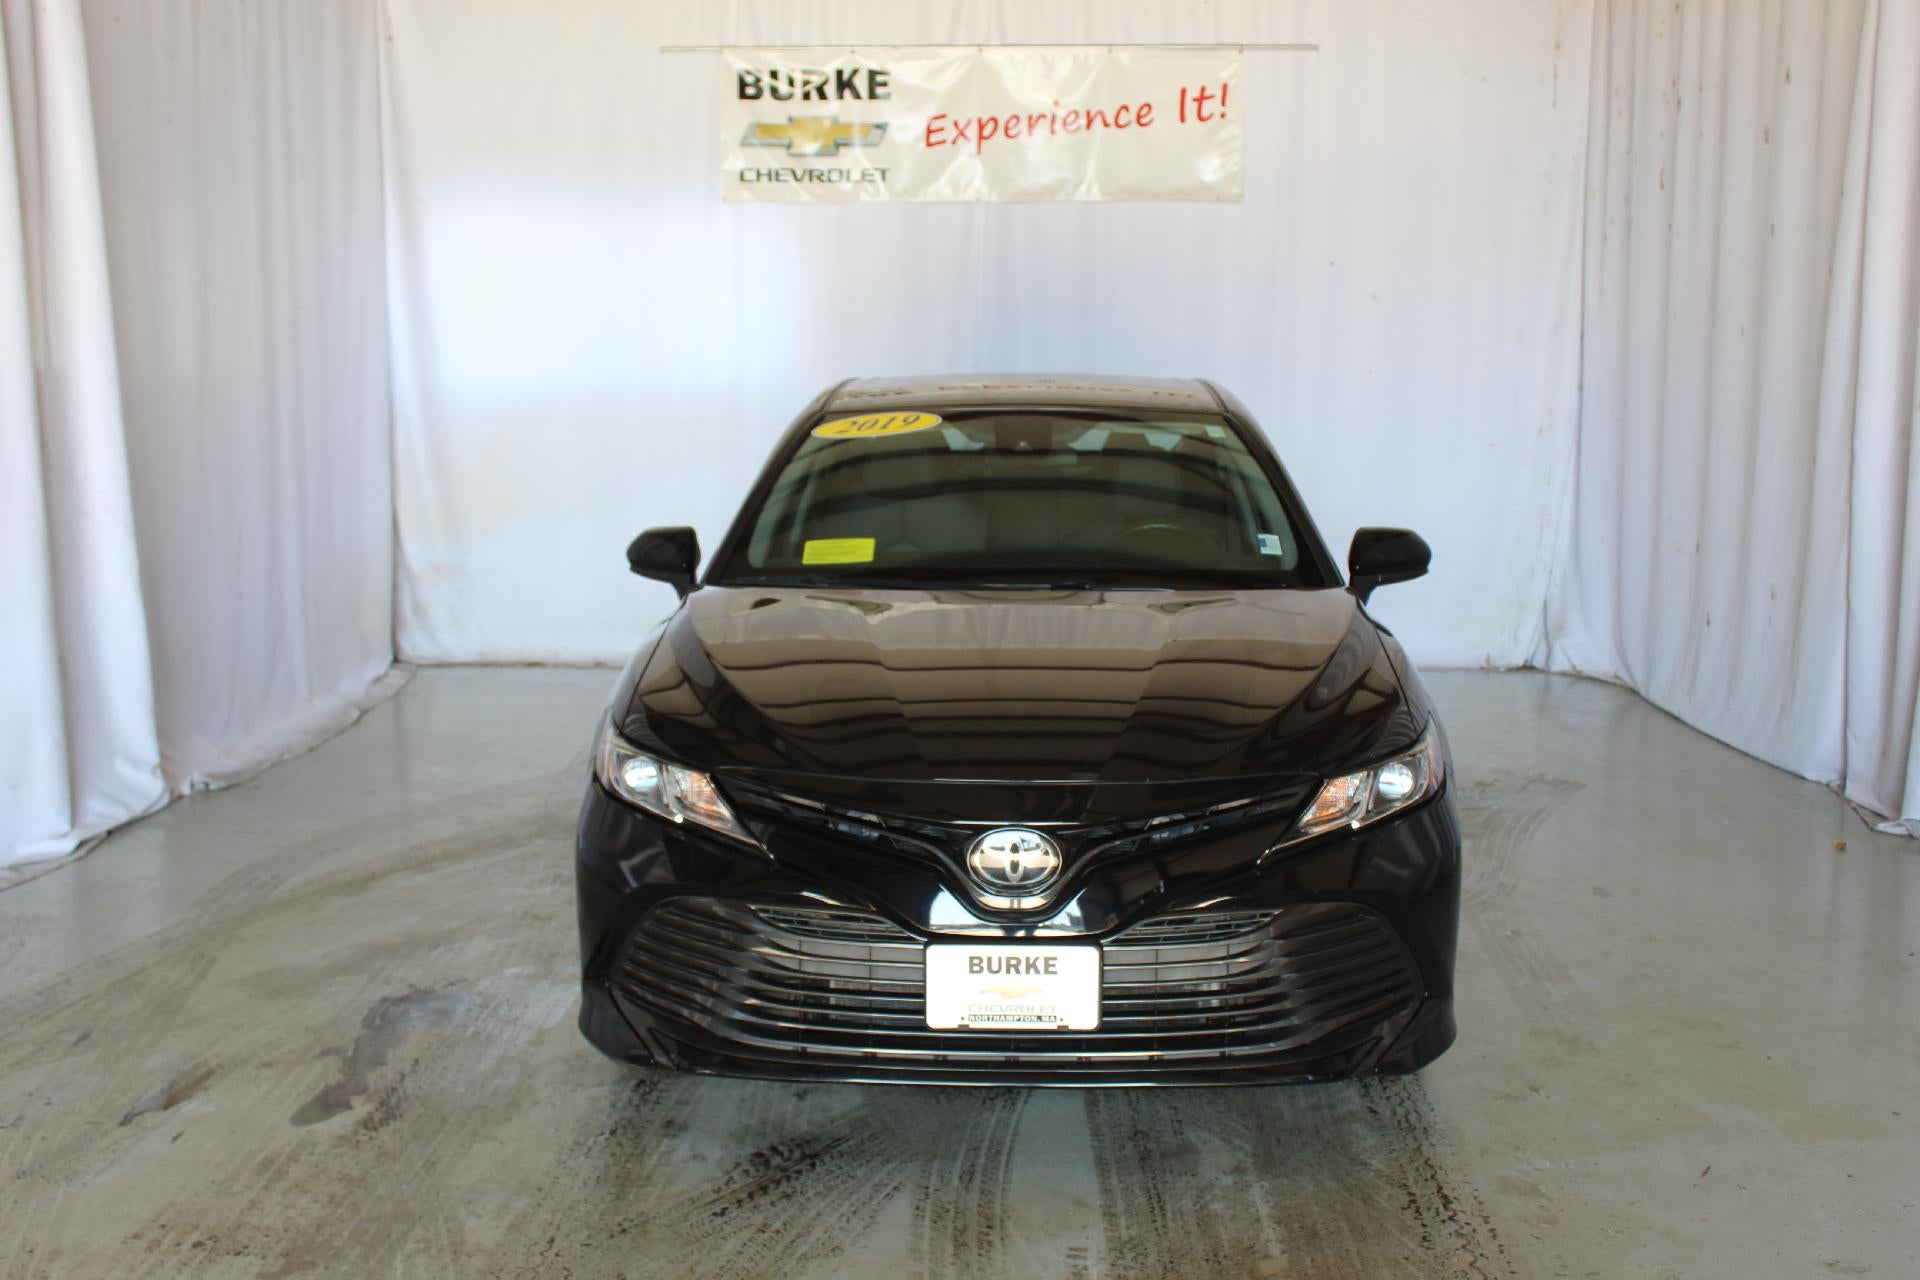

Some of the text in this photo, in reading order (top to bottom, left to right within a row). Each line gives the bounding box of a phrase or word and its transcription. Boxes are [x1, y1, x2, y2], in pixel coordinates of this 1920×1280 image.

[738, 68, 891, 101] BURKE
[925, 83, 1230, 154] Experience It!
[739, 167, 891, 184] CHEVROLET
[836, 414, 920, 434] 2019
[968, 956, 1058, 975] BURKE
[968, 1004, 1057, 1014] CHEVROLET
